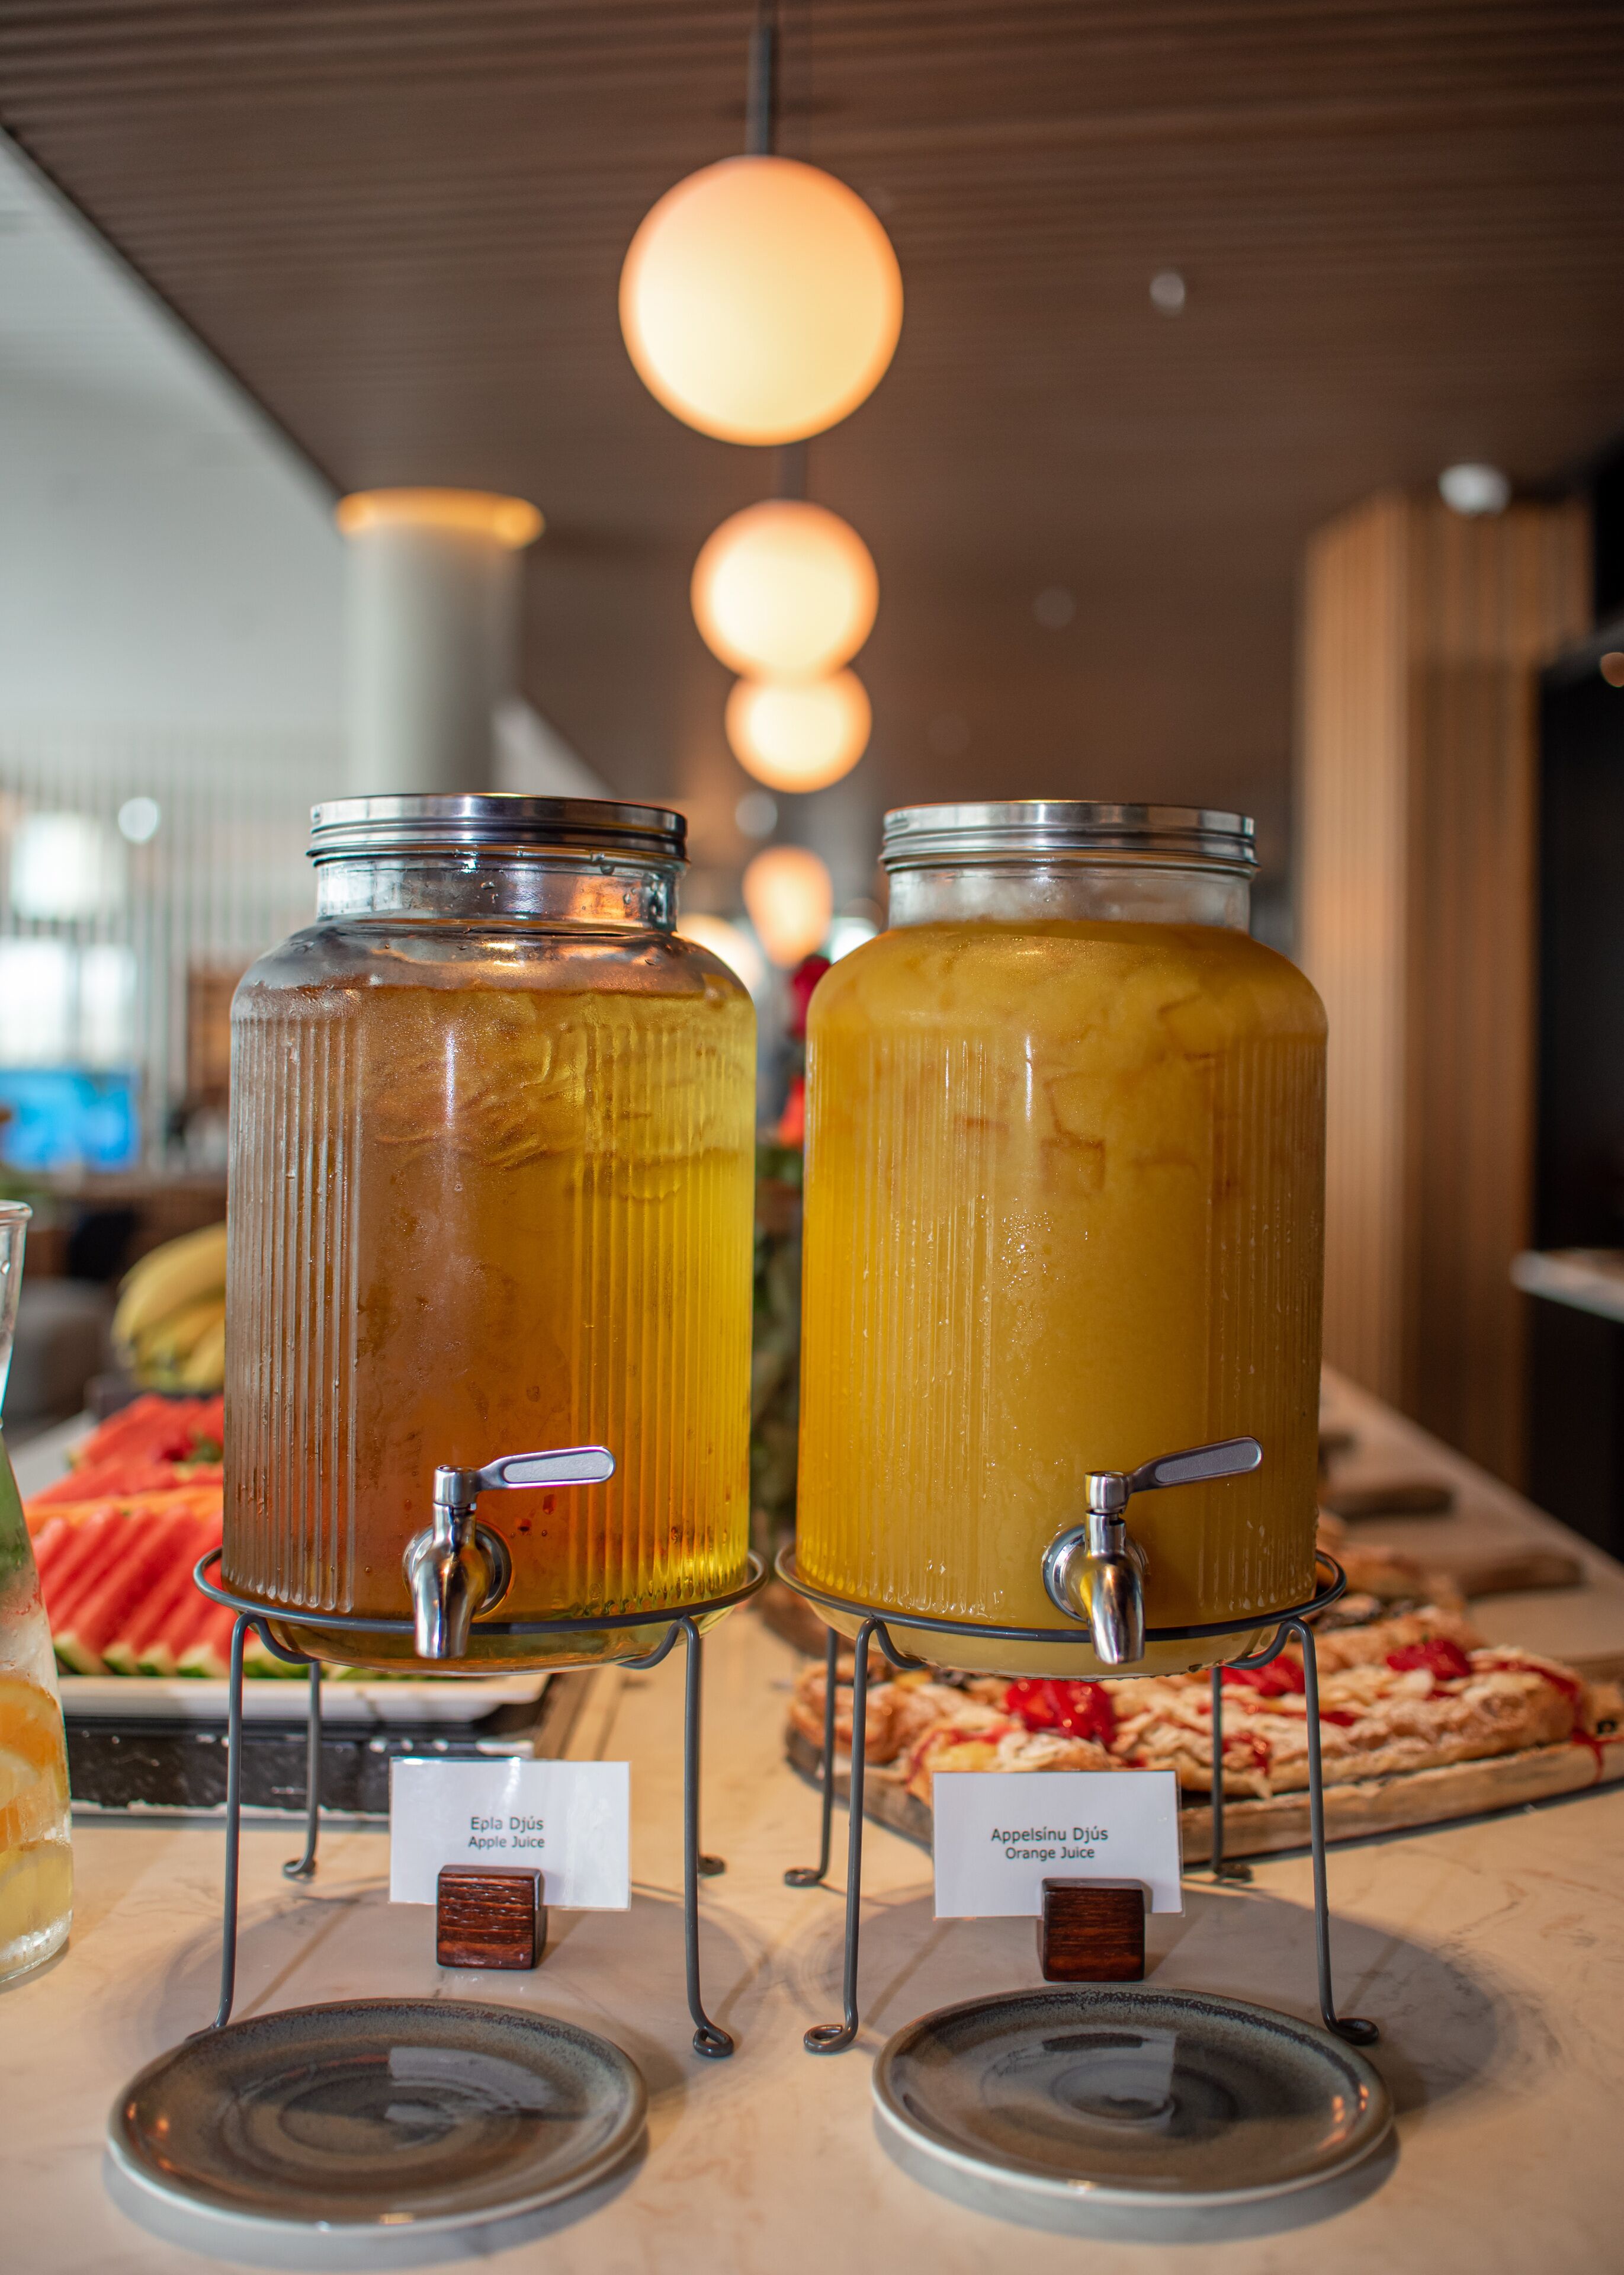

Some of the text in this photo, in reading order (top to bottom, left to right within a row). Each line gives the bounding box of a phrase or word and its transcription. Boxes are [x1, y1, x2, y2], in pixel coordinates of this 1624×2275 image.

[470, 1816, 544, 1834] Epla Djús
[991, 1825, 1109, 1844] Appelsínu Djús
[468, 1836, 545, 1850] Apple Juice
[1005, 1847, 1095, 1861] Orange Juice
